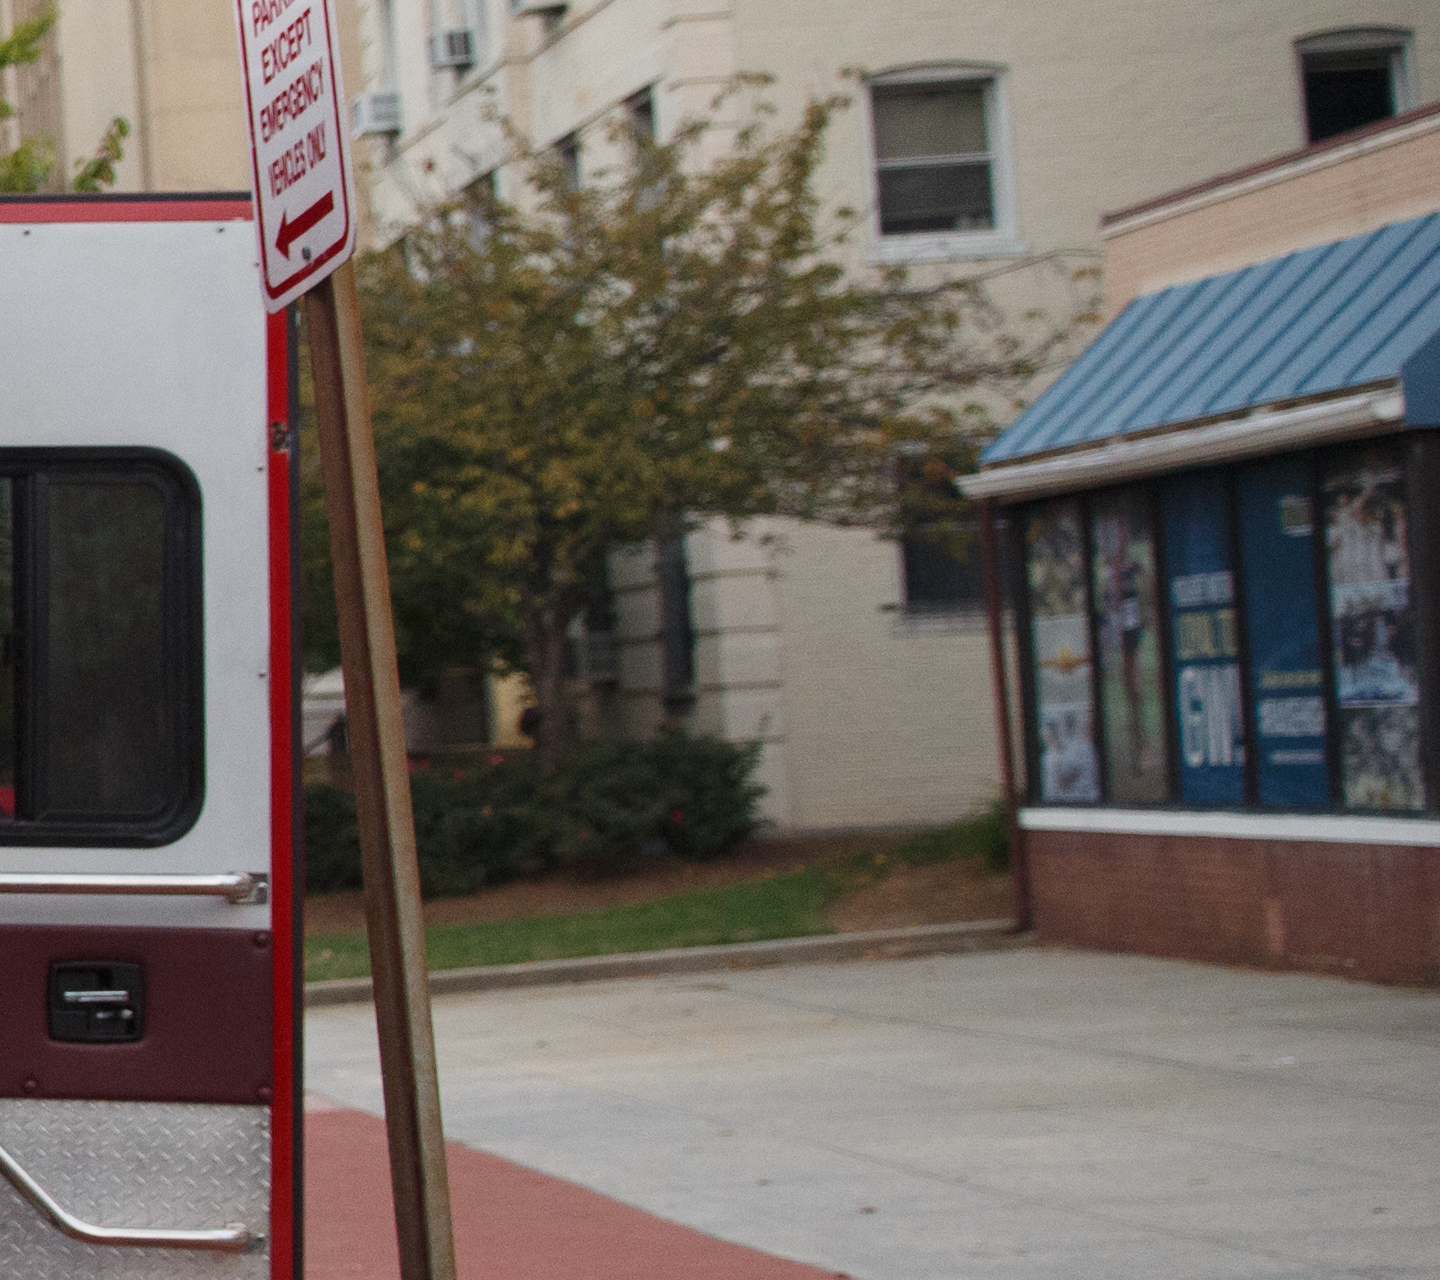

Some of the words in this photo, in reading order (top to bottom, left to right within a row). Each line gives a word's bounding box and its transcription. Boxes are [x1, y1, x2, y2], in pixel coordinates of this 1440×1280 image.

[261, 6, 311, 85] EXCEPT
[260, 58, 324, 143] EMERGENCY
[268, 139, 307, 199] VEHICLES
[306, 120, 326, 169] ONLY
